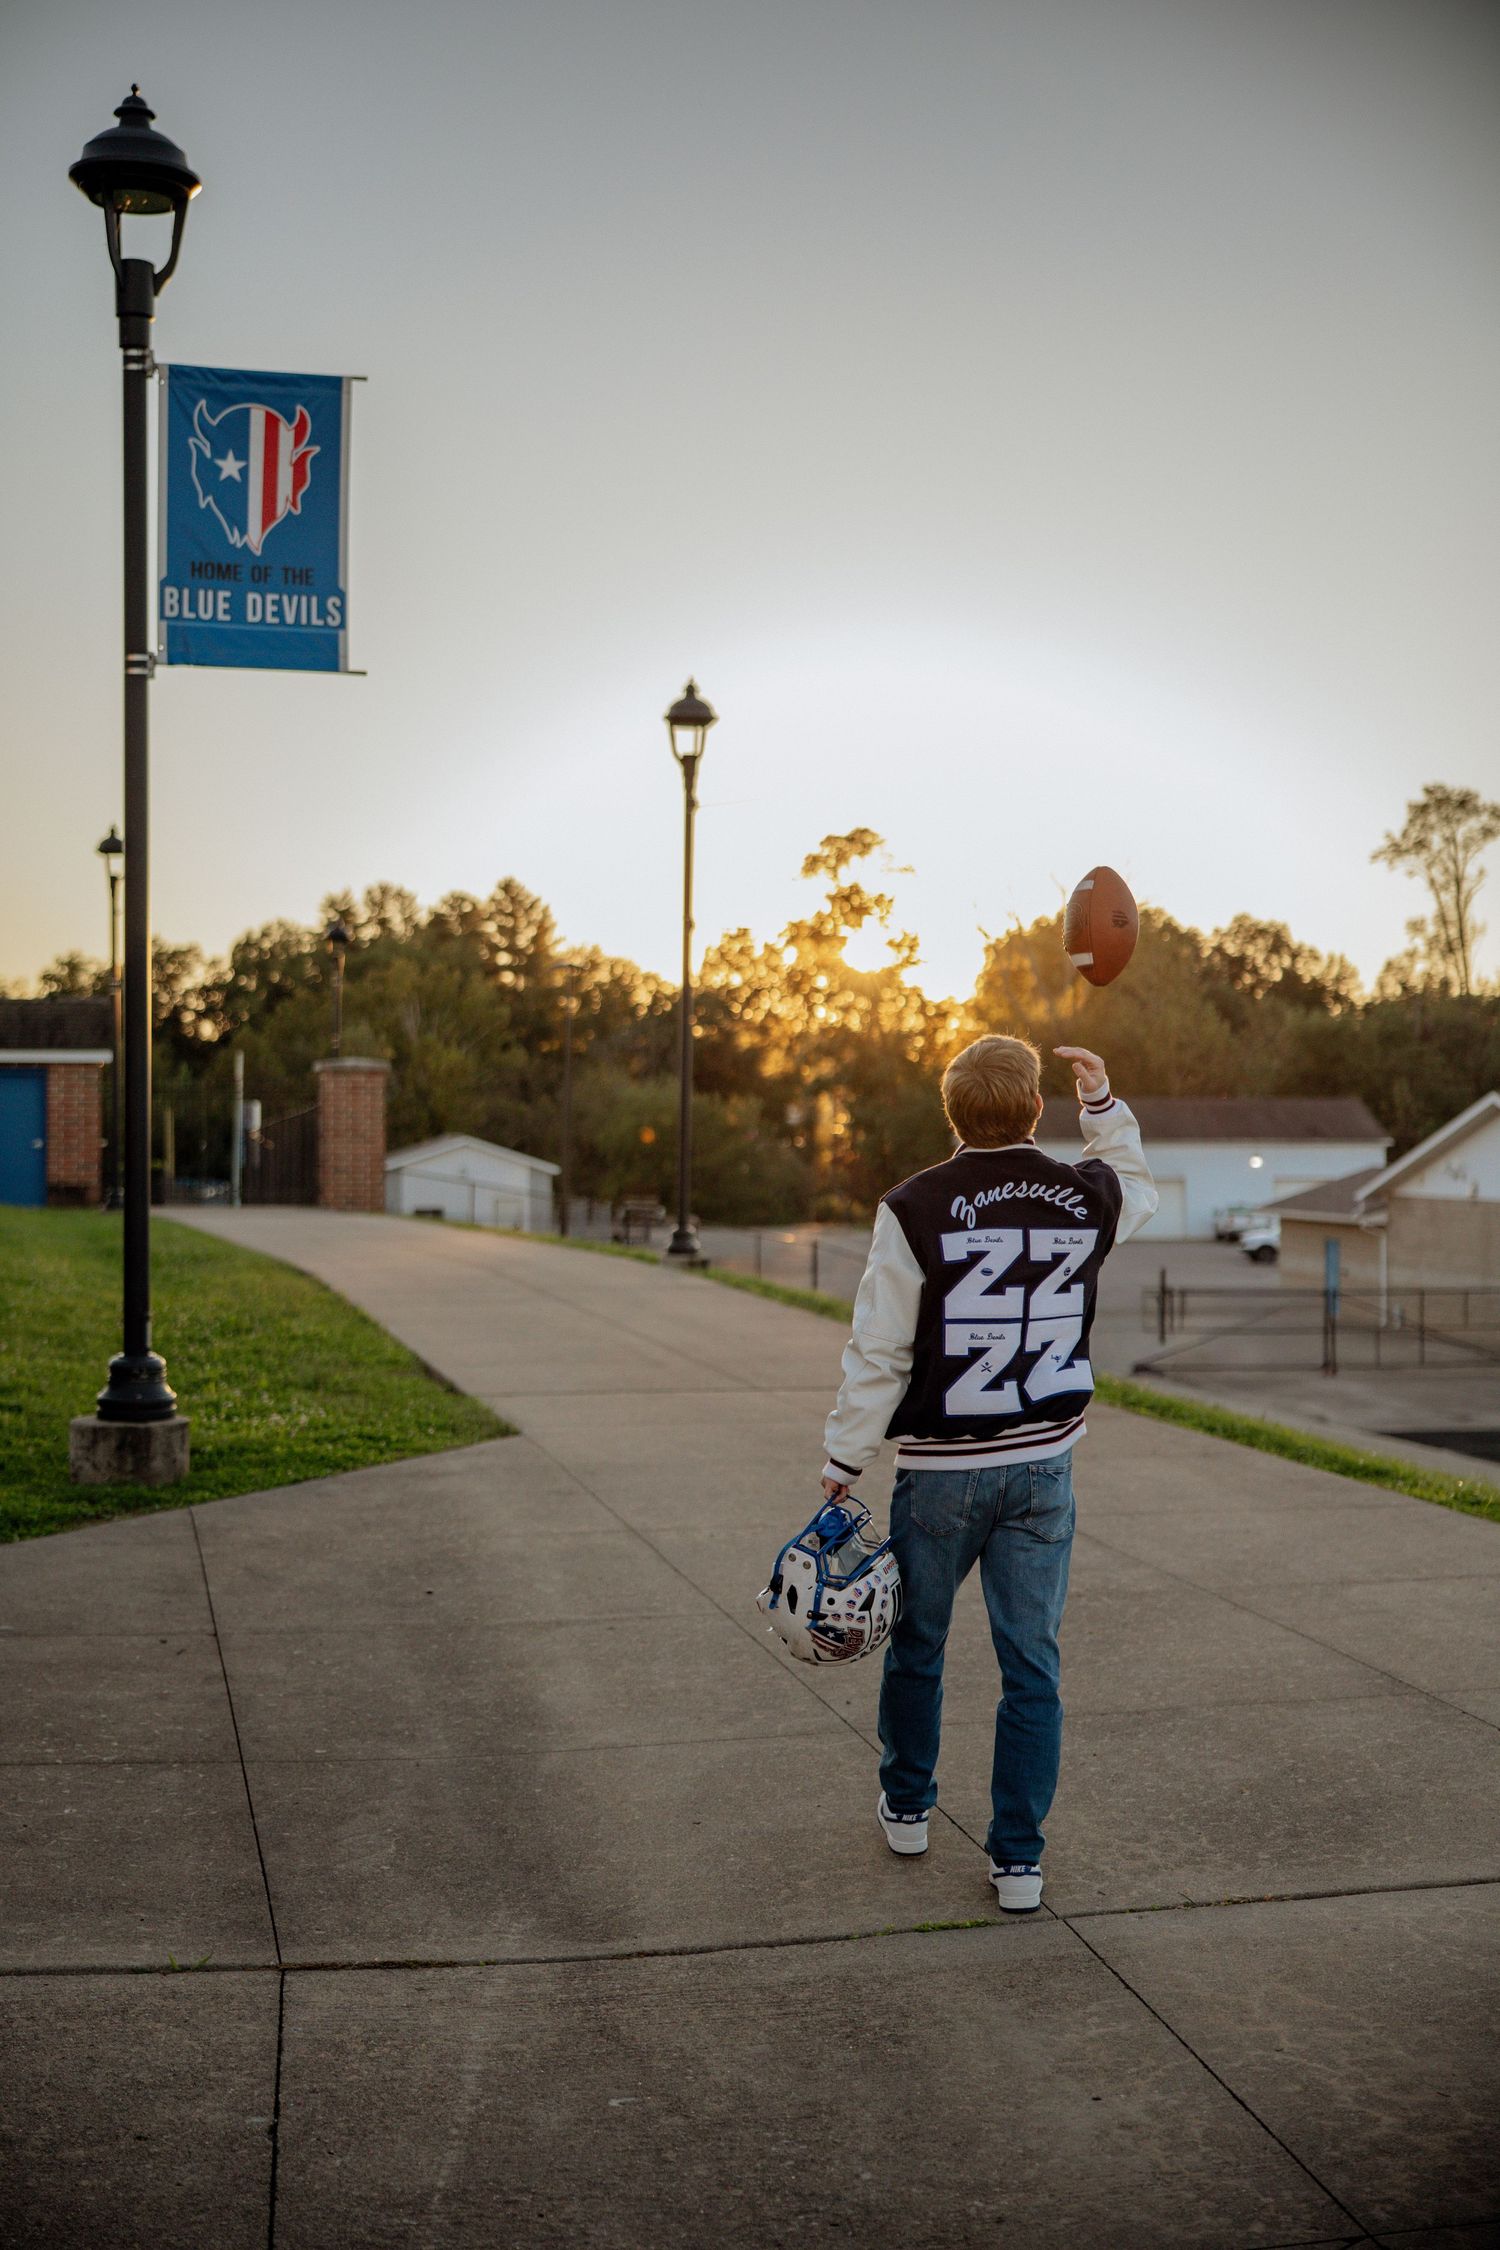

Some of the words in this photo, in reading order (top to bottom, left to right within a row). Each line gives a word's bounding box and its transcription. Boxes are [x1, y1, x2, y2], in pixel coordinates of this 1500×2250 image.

[190, 560, 243, 582] HOME
[251, 565, 272, 584] OF
[282, 566, 315, 586] THE
[163, 586, 232, 622] BLUE
[246, 591, 342, 627] DEVILS
[950, 1181, 1088, 1229] Zanesville
[901, 1814, 917, 1822] NIKE
[1009, 1865, 1026, 1873] NIKE
